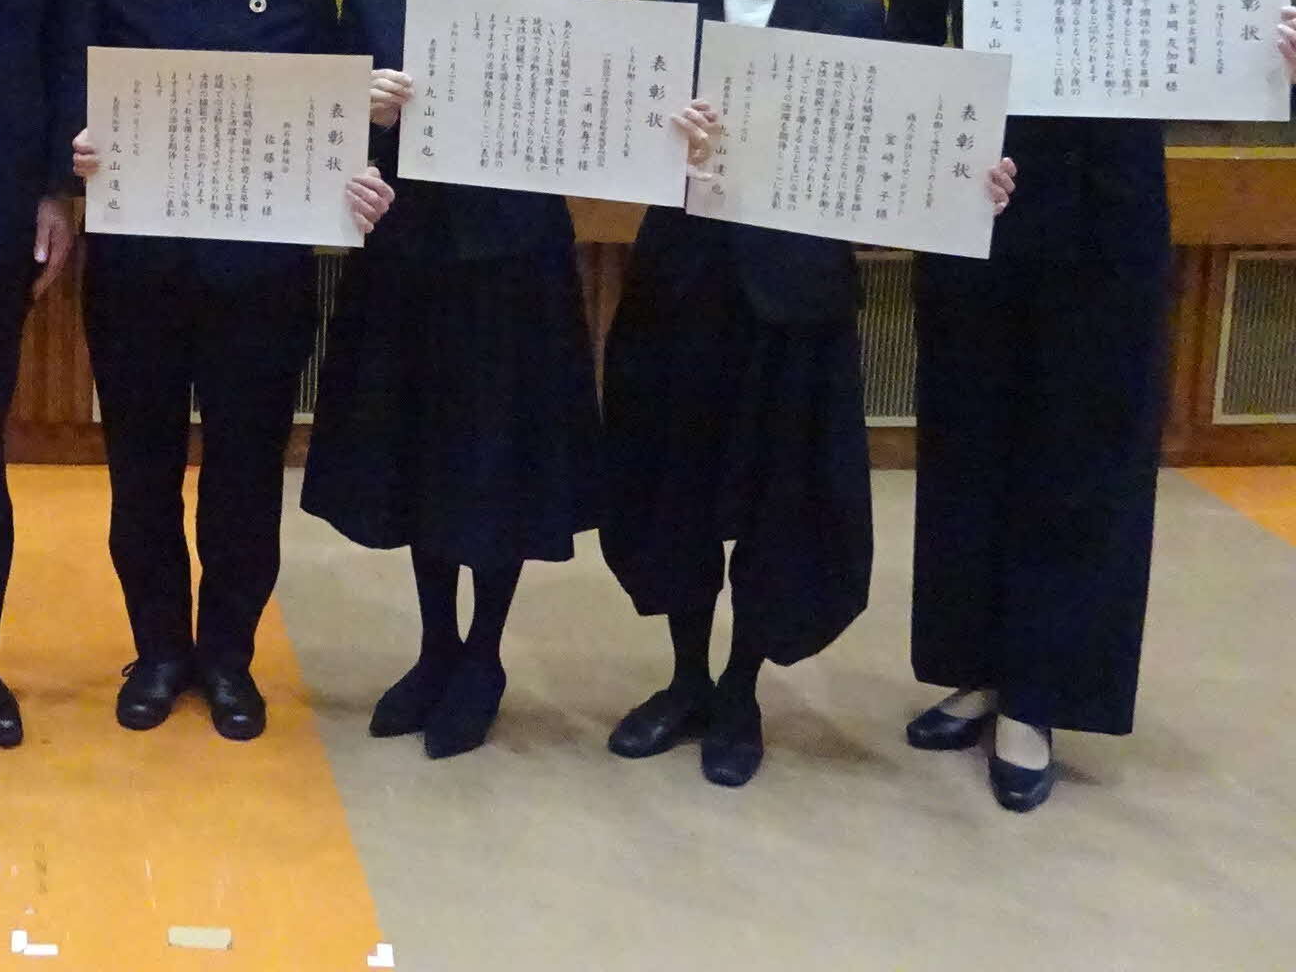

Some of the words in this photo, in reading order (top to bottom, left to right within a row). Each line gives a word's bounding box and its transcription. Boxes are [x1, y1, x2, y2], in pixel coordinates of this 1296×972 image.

[472, 12, 482, 39] します
[987, 16, 1003, 50] 丸山
[420, 85, 438, 157] 丸山達也
[645, 54, 667, 128] 表彰状
[325, 101, 345, 171] 表彰状
[952, 103, 977, 178] 表彰状
[106, 140, 123, 210] 丸山達也
